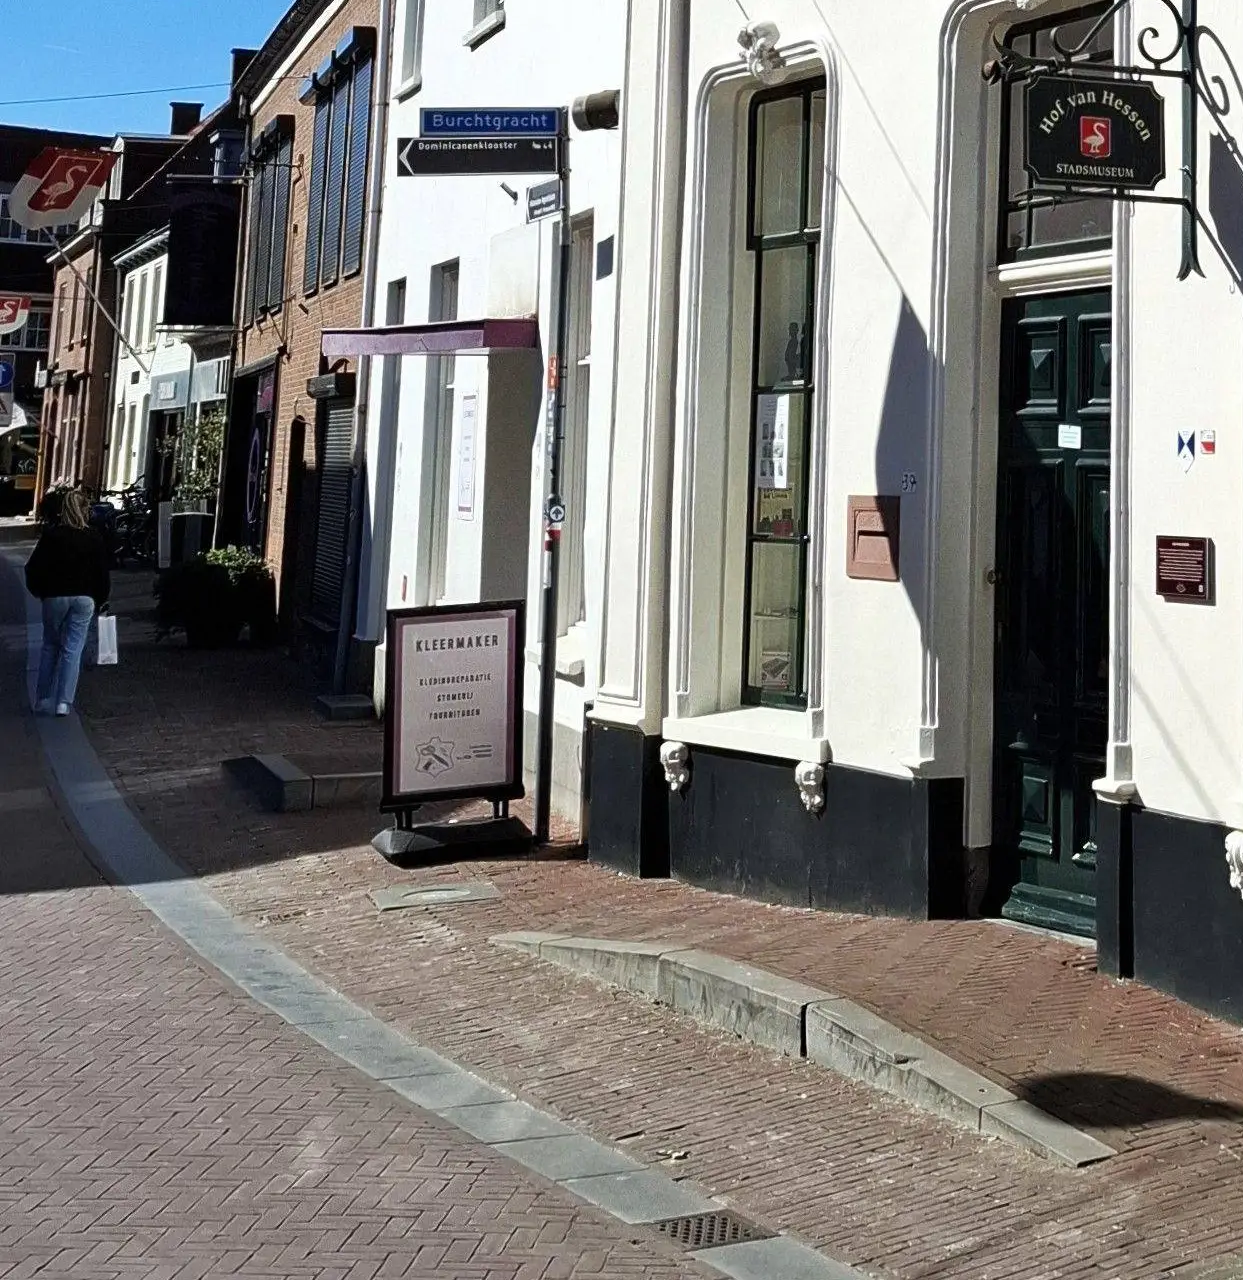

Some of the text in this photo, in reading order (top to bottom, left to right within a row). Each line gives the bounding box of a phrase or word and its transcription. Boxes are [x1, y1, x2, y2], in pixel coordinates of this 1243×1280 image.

[433, 113, 548, 131] Burchtgracht
[1039, 90, 1151, 142] Hof van Hessen
[418, 142, 518, 151] Dominicanenklooster
[1056, 163, 1134, 179] STADSMUSEUM
[416, 635, 499, 652] KLEERMAKER
